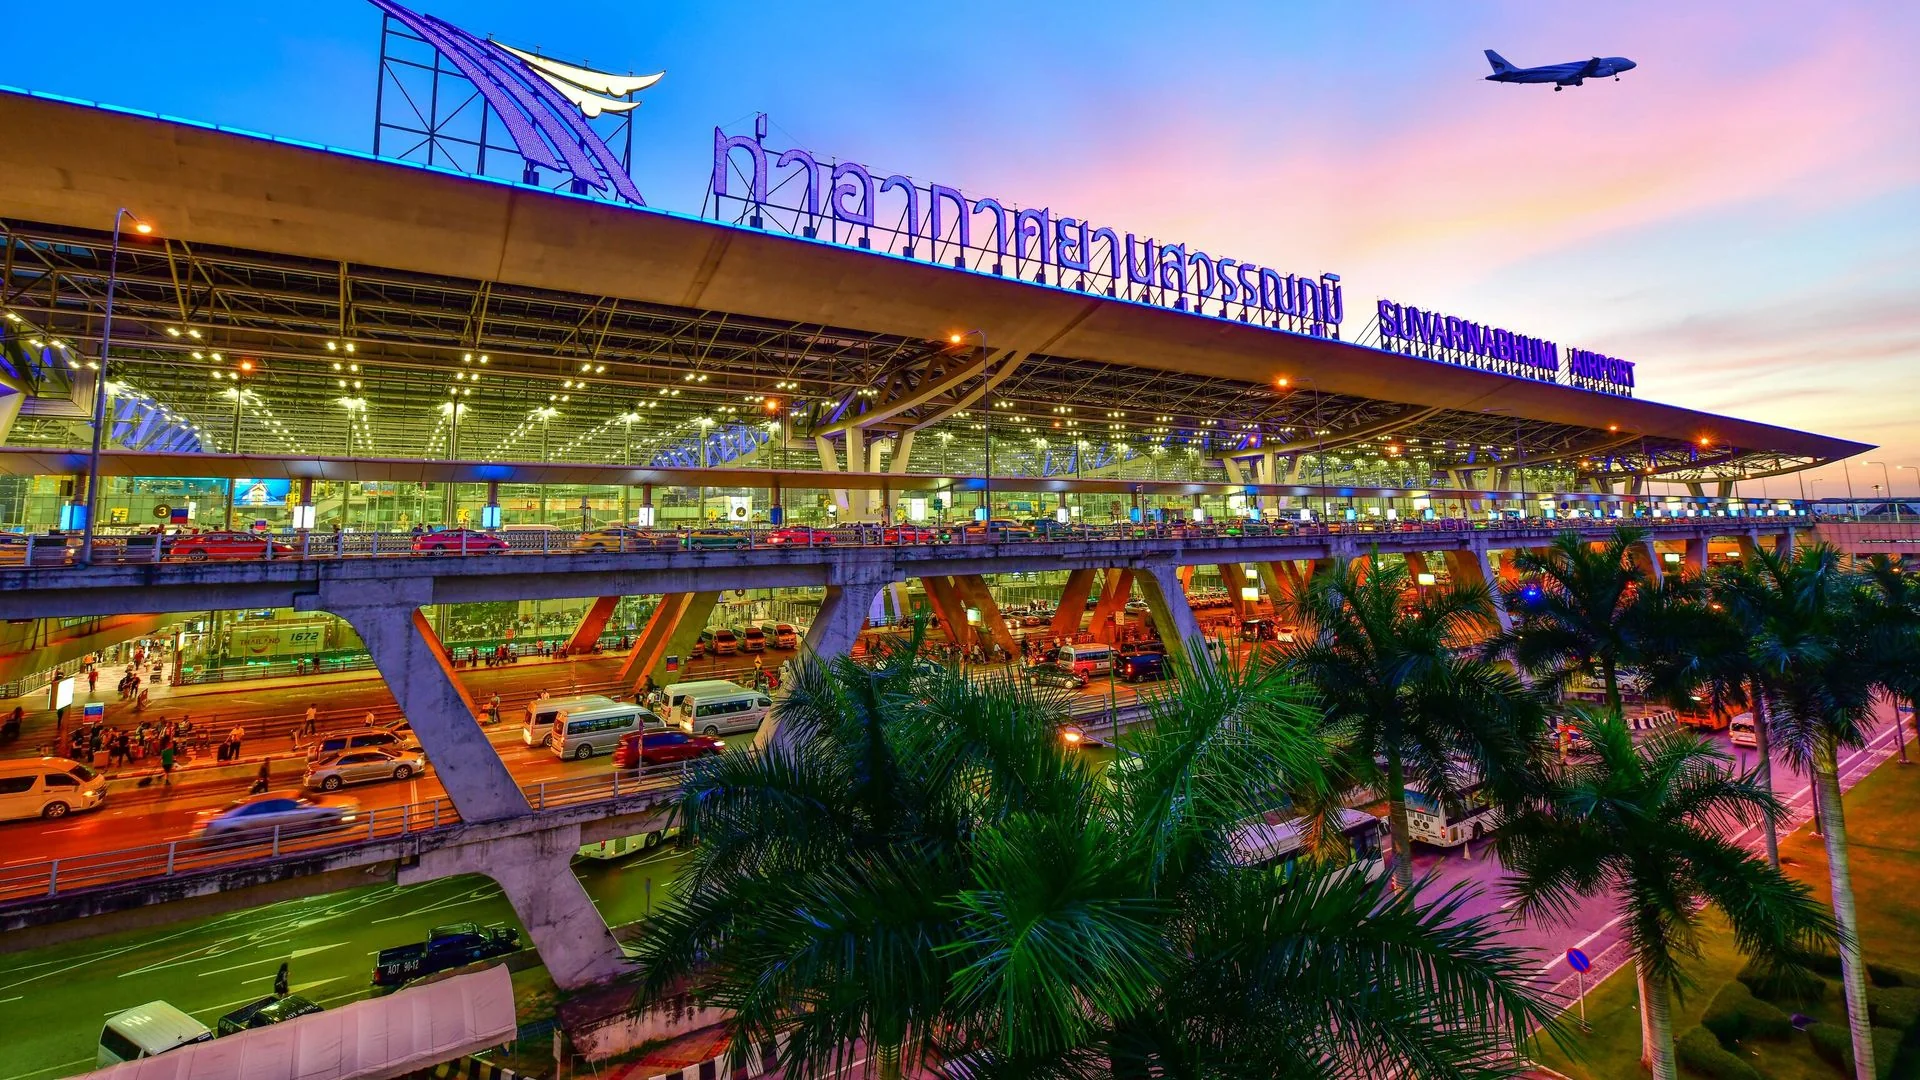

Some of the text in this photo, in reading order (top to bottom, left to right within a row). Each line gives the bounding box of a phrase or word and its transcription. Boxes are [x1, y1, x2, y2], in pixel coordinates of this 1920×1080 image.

[713, 113, 1344, 337] ท่าอากาศยานสุวรรณภูมิ
[1379, 299, 1636, 388] SUVARNABHUMI AIRPORT
[158, 507, 167, 516] 3
[239, 637, 281, 647] THAILAND
[290, 631, 319, 642] 1672
[387, 964, 400, 976] AOT
